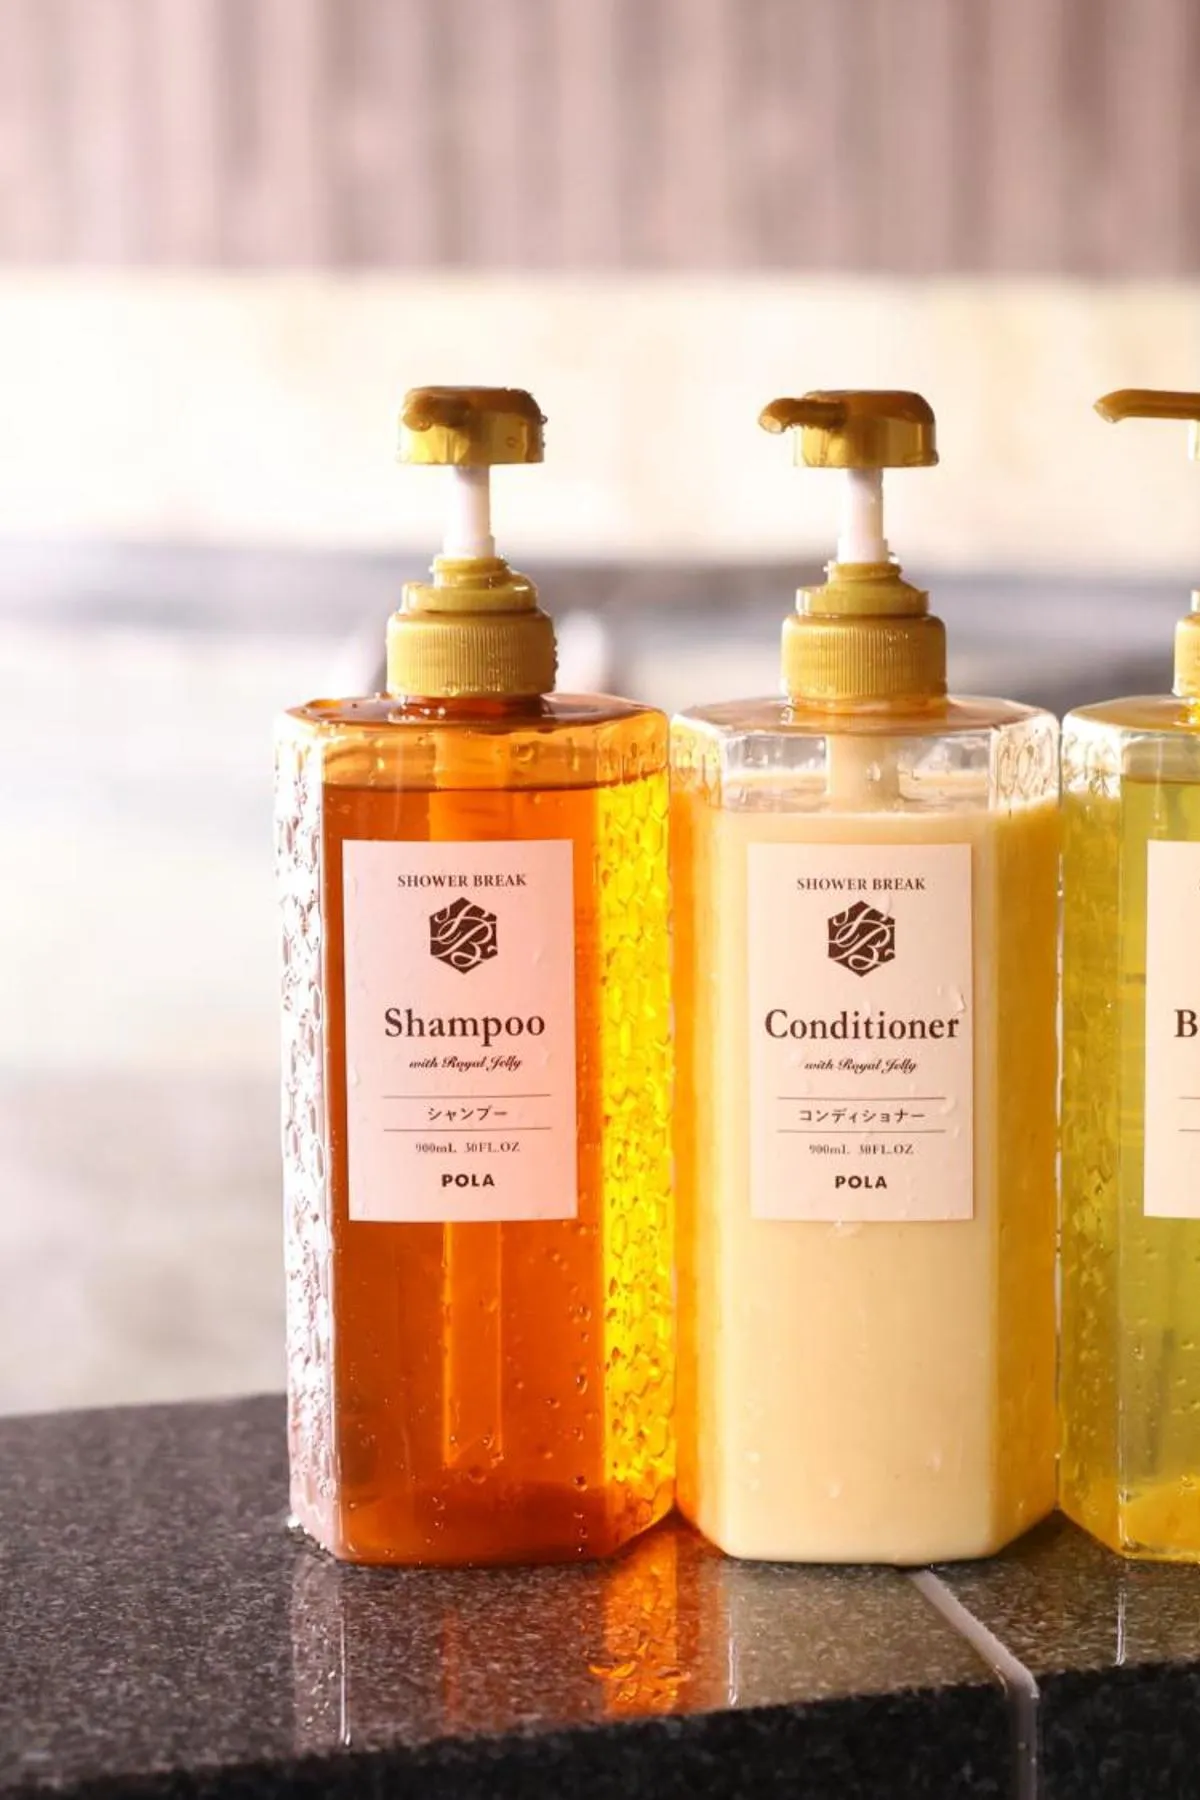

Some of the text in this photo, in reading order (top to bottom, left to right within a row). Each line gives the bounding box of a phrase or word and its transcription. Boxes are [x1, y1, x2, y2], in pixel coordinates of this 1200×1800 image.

[398, 874, 527, 888] SHOWER BREAK
[797, 878, 926, 891] SHOWER BREAK
[384, 1007, 546, 1047] Shampoo
[764, 1008, 960, 1040] Conditioner
[409, 1055, 522, 1072] with Royal Jelly
[804, 1058, 917, 1074] with Royal Jelly
[427, 1105, 508, 1121] シャンプー
[799, 1108, 926, 1124] コンディショナー
[441, 1174, 495, 1187] POLA
[834, 1175, 888, 1189] POLA
